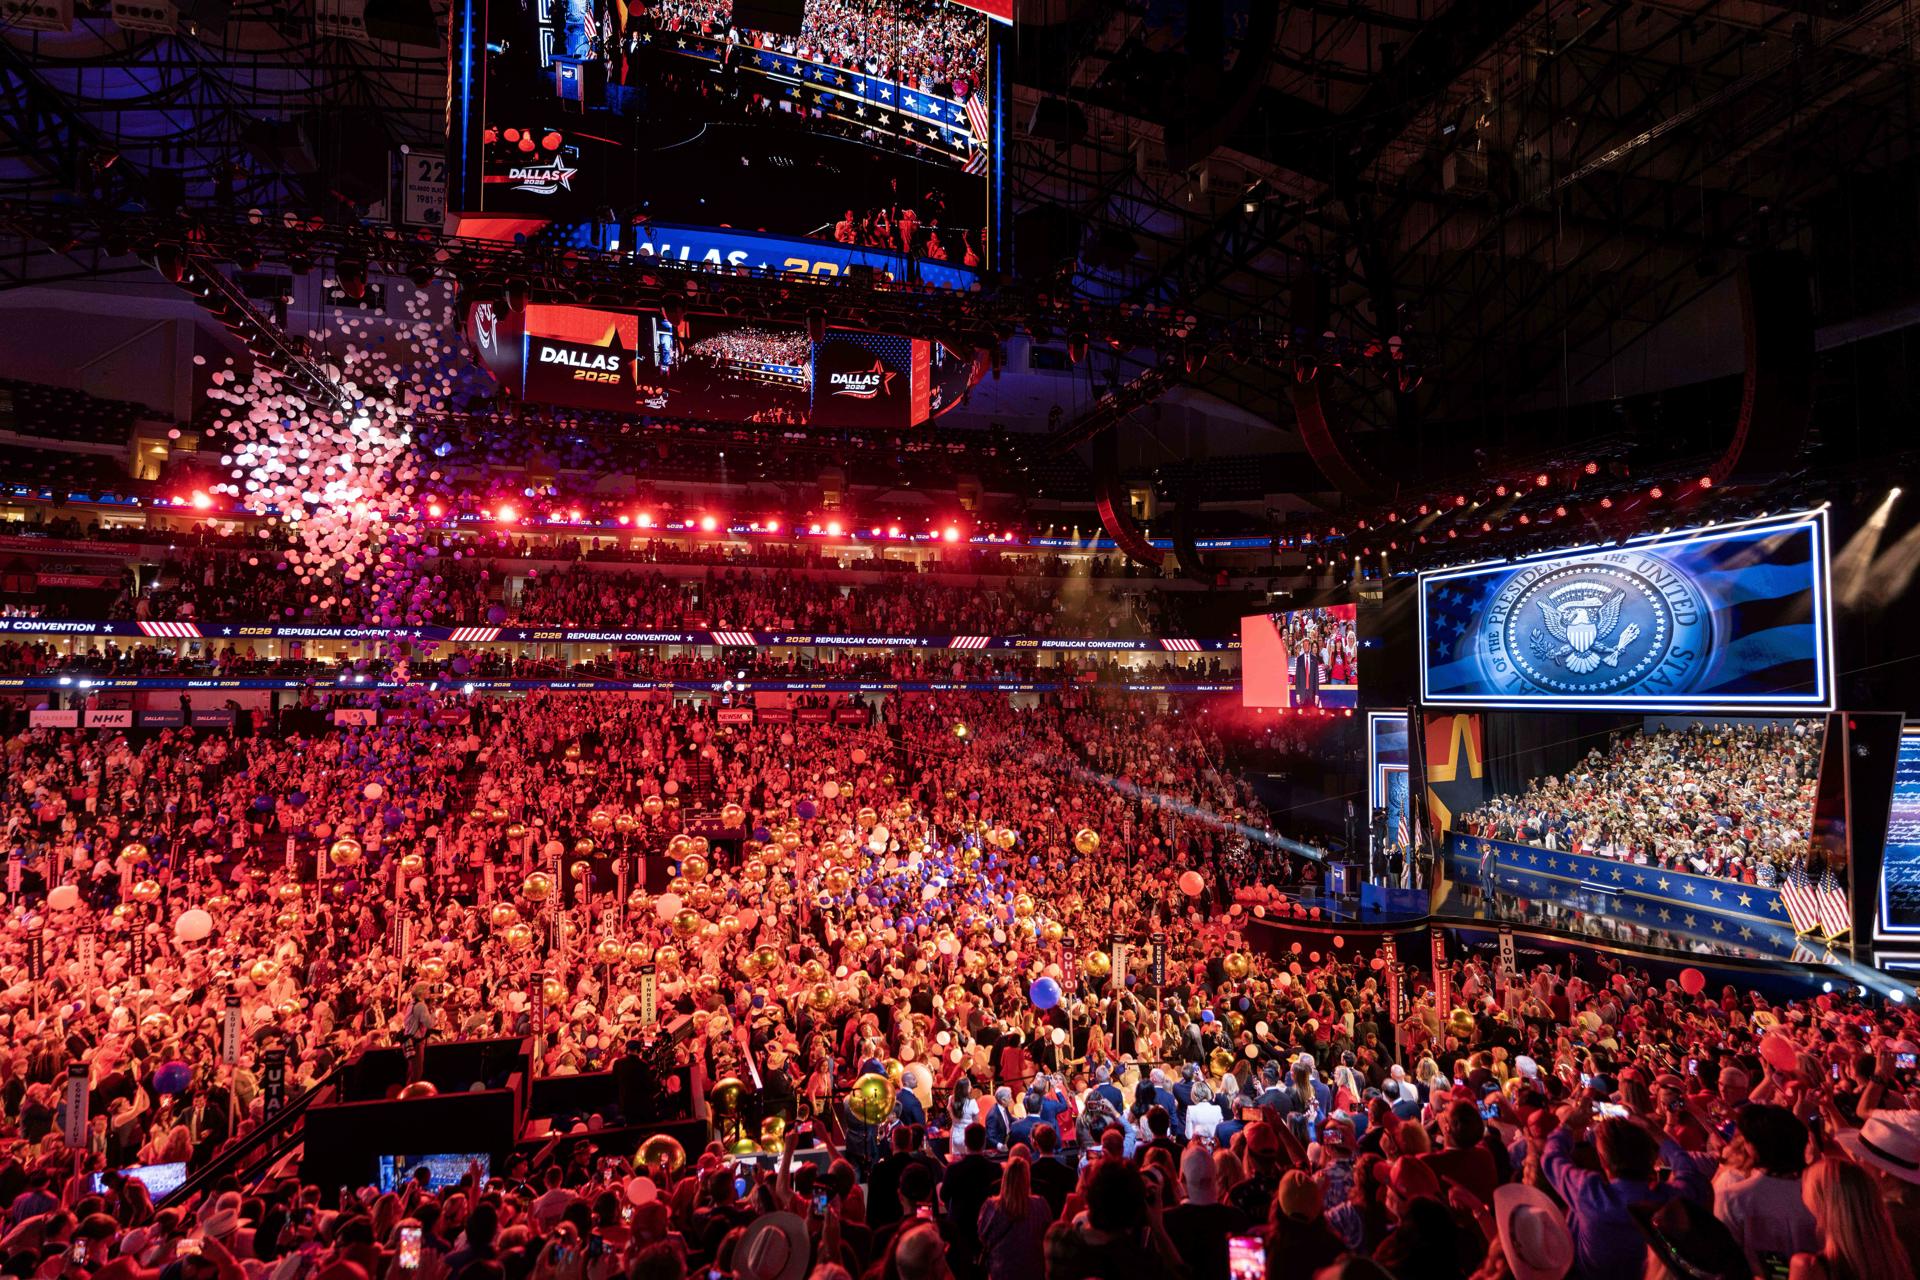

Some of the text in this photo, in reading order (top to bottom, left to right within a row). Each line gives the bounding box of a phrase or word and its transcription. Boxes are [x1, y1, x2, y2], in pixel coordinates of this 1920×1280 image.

[418, 160, 444, 182] 22
[509, 168, 560, 181] DALLAS
[540, 346, 620, 371] DALLAS
[573, 369, 621, 384] 2026
[830, 373, 880, 385] DALLAS
[1489, 559, 1572, 625] PRESIDENT
[1602, 552, 1629, 564] THE
[1637, 560, 1699, 627] UNITED
[13, 621, 95, 632] CONVENTION
[239, 627, 272, 635] 2026
[277, 628, 341, 637] REPUBLICAN
[567, 632, 622, 641] REPUBLICAN
[625, 633, 681, 642] CONVENTION
[815, 636, 864, 644] REPUBLICAN
[1488, 630, 1501, 655] THE
[1492, 656, 1507, 673] OF
[92, 715, 125, 723] NHK
[83, 937, 91, 976] WYOMING
[133, 934, 142, 975] MONTANA
[1503, 939, 1514, 973] IOWA
[1064, 951, 1074, 989] OHIO
[532, 986, 541, 1031] TEXAS
[228, 1011, 236, 1061] LOUISIANA
[73, 1082, 81, 1143] CONNECTICUT
